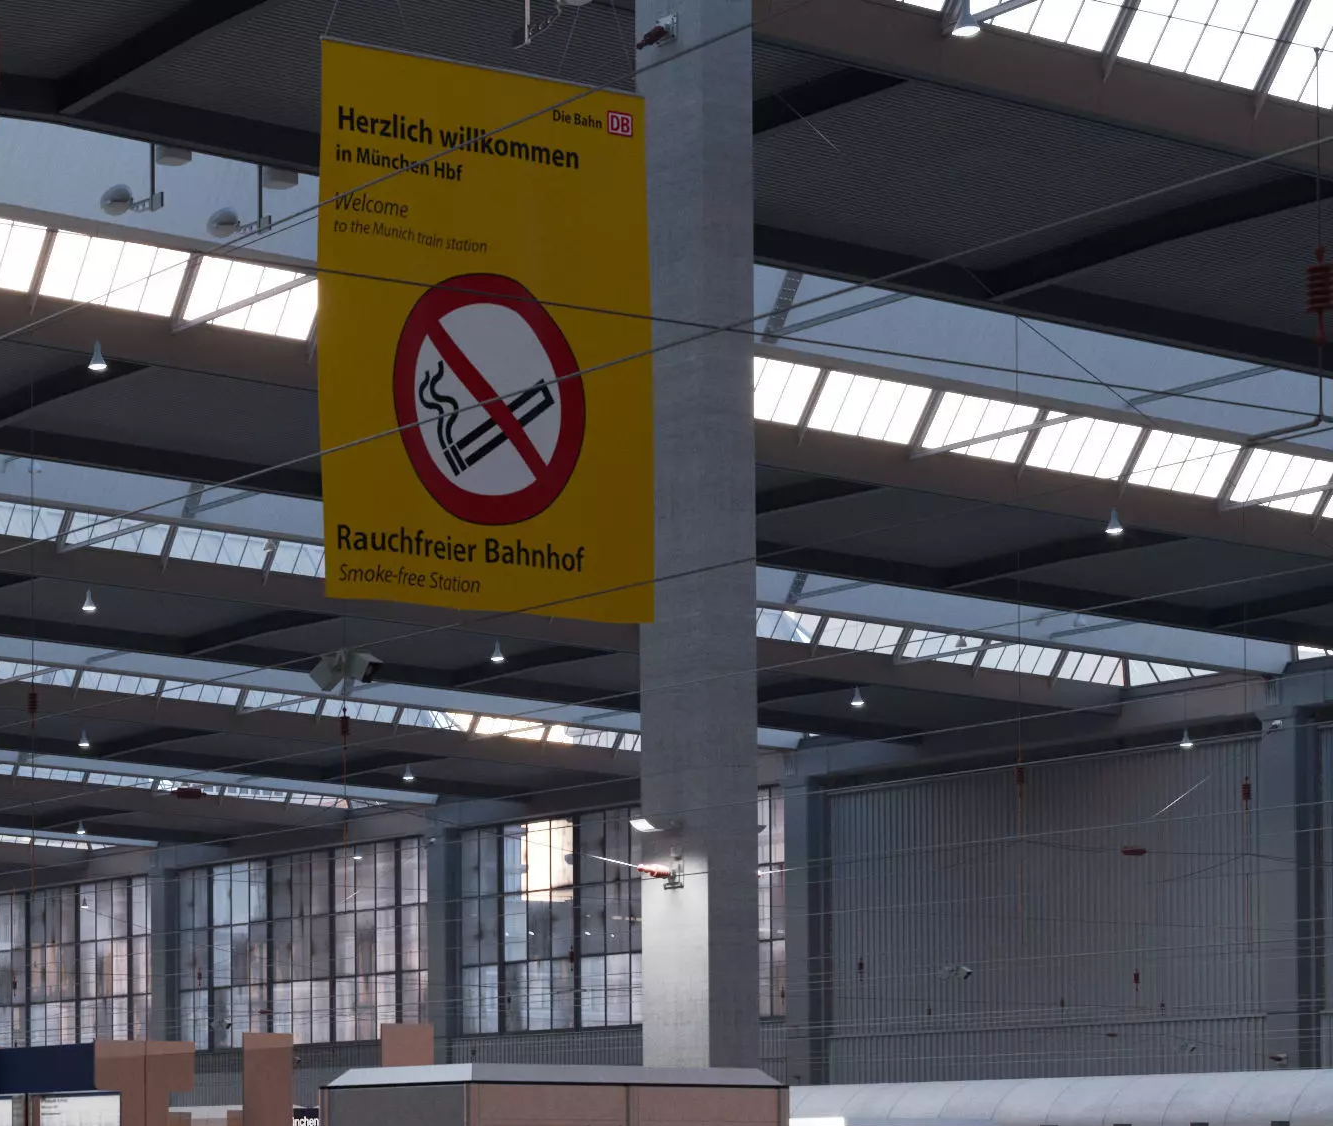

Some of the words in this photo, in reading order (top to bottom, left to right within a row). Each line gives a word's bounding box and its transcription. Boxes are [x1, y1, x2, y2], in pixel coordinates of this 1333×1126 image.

[552, 109, 572, 124] Die
[574, 113, 603, 129] Bahn
[610, 114, 630, 133] DB
[337, 105, 433, 146] Herzlich
[439, 127, 580, 169] willkommen
[336, 144, 352, 162] in
[356, 147, 430, 176] München
[434, 160, 463, 181] Hbf
[334, 191, 409, 218] Welcome
[333, 220, 348, 233] to
[351, 219, 370, 234] the
[372, 221, 415, 241] Munich
[417, 231, 444, 249] train
[445, 237, 488, 254] station
[336, 524, 477, 563] Rauchfreier
[484, 538, 586, 572] Bahnhof
[338, 563, 426, 589] Smoke-free
[428, 571, 481, 593] Station
[292, 1116, 319, 1126] nchen
